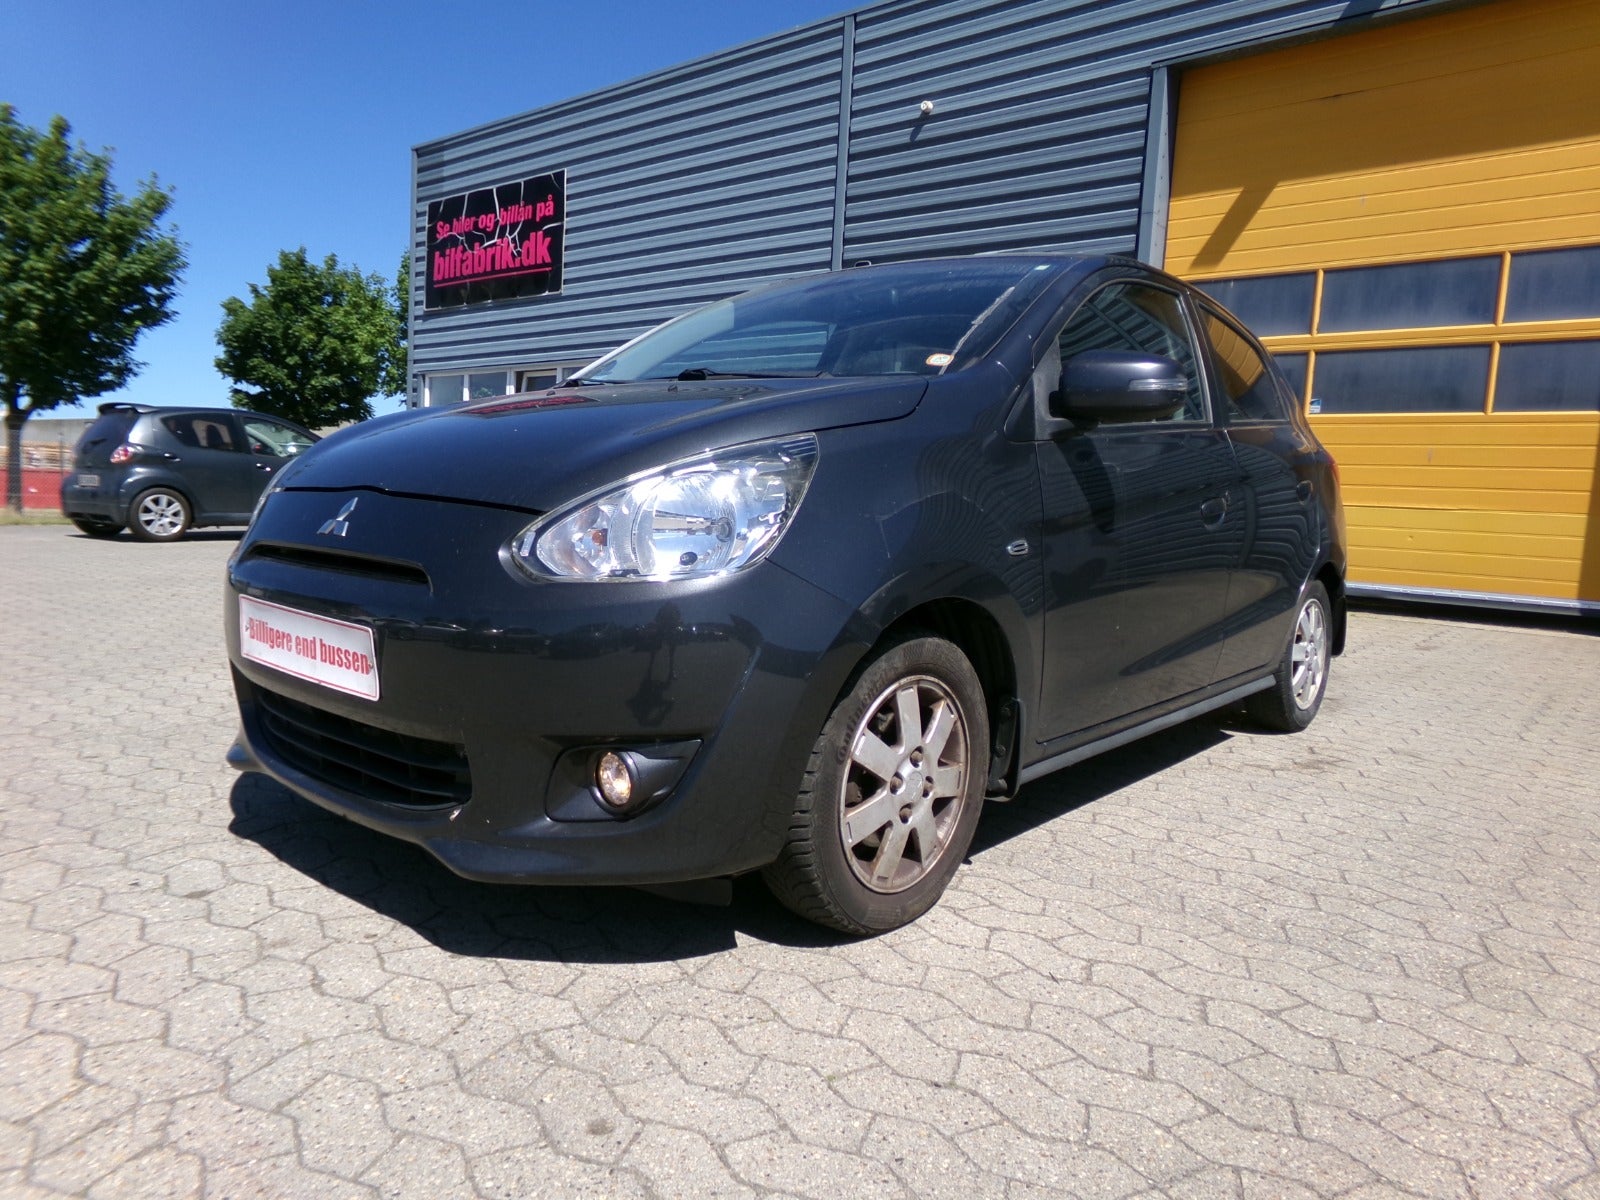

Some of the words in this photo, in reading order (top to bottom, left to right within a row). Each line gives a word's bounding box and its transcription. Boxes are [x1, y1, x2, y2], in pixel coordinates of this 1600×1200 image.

[436, 220, 450, 239] Se
[452, 216, 475, 233] biler
[478, 213, 496, 232] og
[500, 200, 532, 225] billån
[535, 194, 554, 222] på
[433, 231, 552, 281] bilfabrik.dk
[249, 617, 293, 652] Billigere
[295, 635, 317, 660] end
[319, 638, 370, 675] bussen
